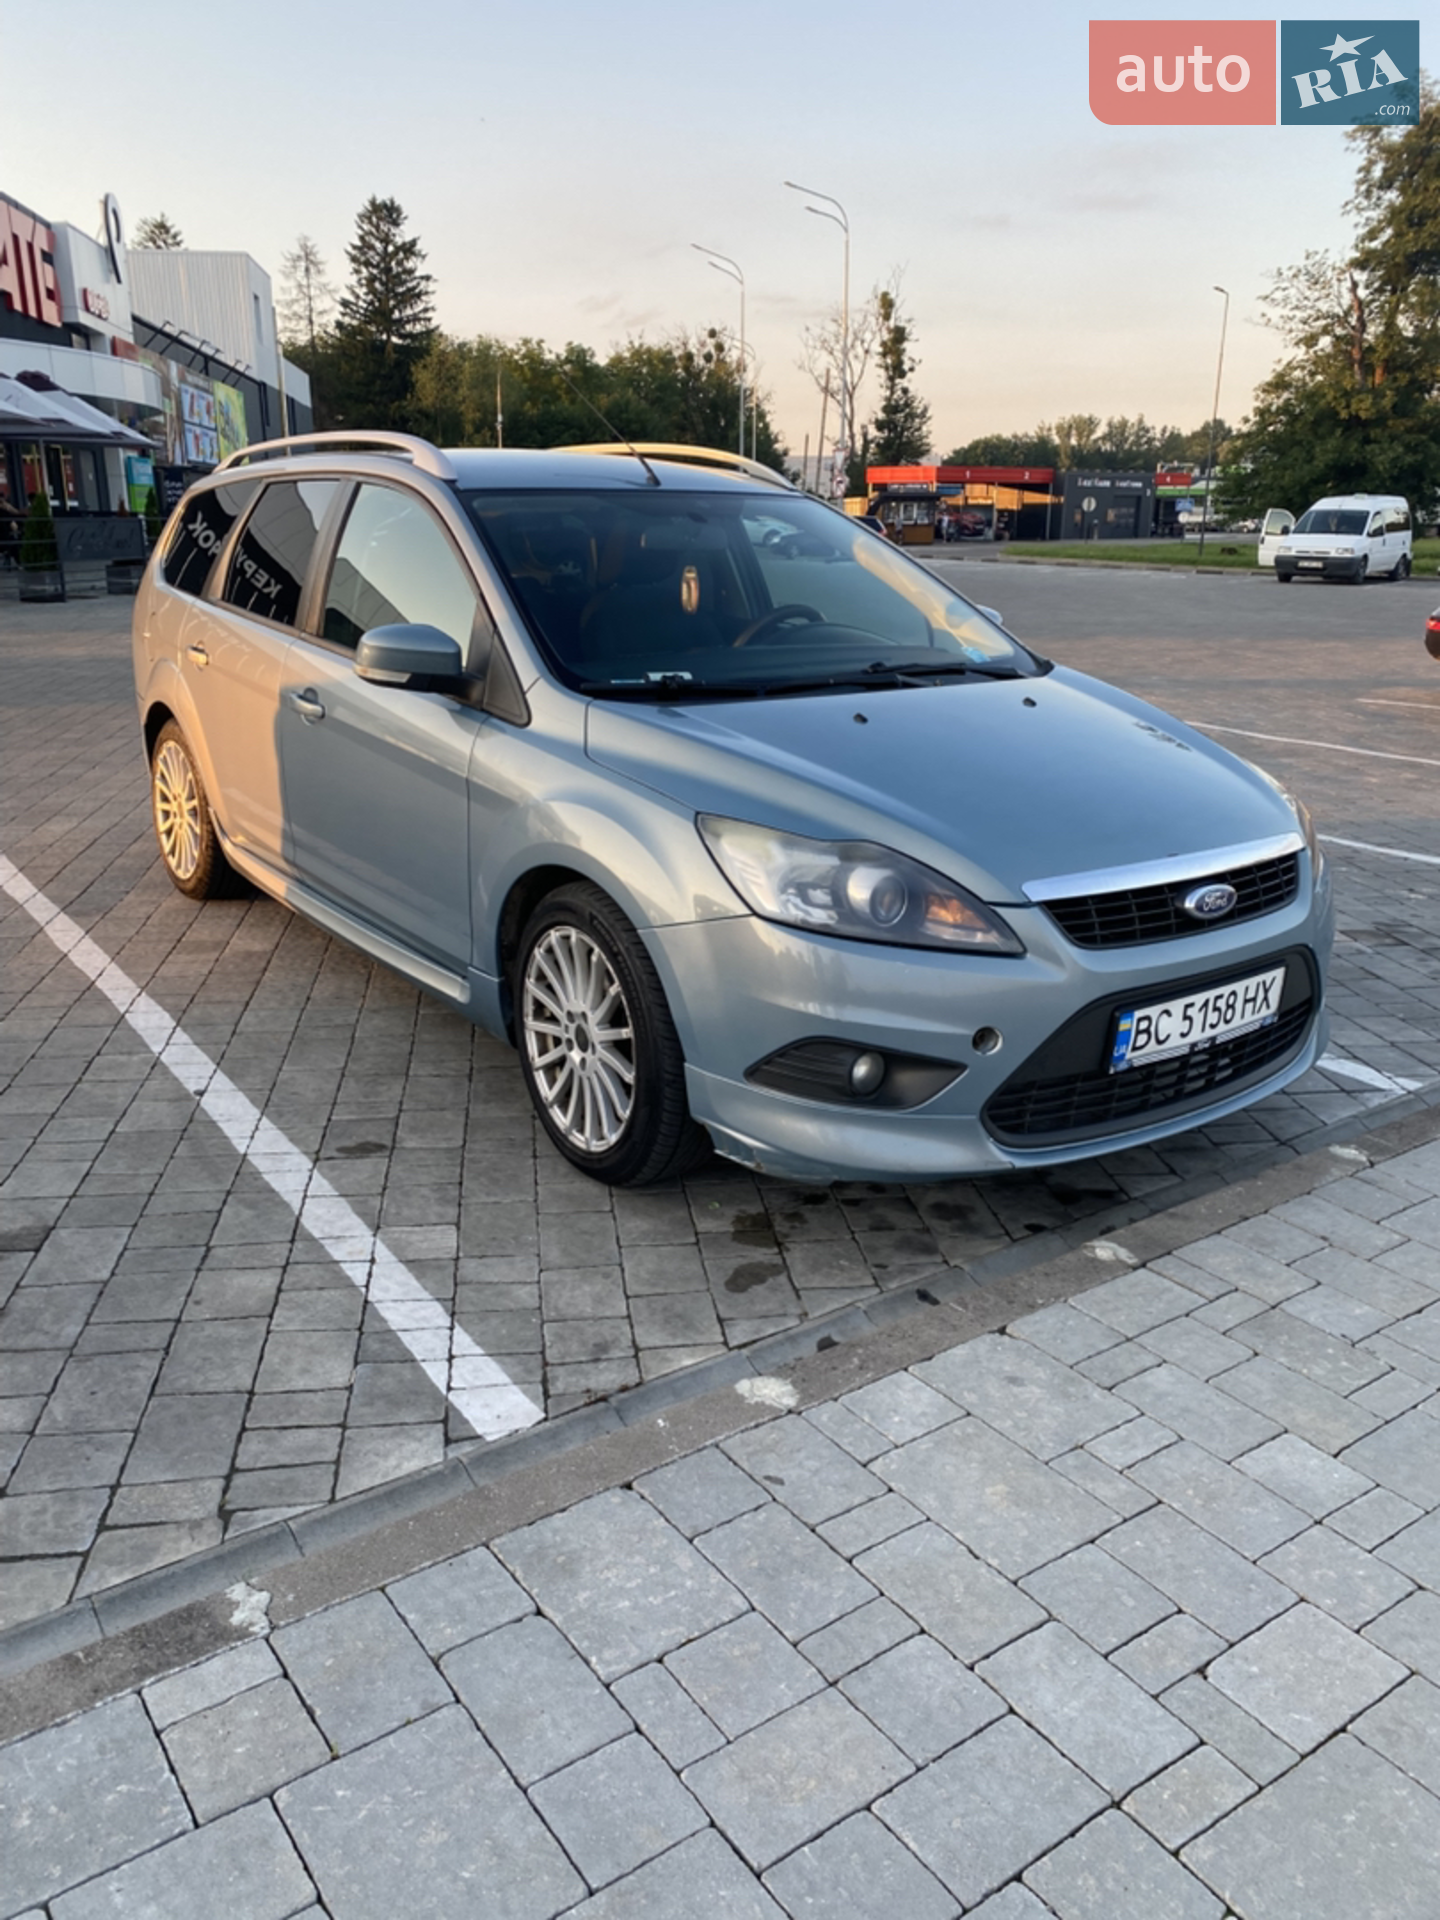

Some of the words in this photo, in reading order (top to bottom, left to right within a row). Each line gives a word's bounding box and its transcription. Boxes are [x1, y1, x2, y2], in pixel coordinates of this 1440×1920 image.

[1130, 1008, 1173, 1053] BC
[1179, 990, 1238, 1039] 5158
[1240, 975, 1277, 1020] HX
